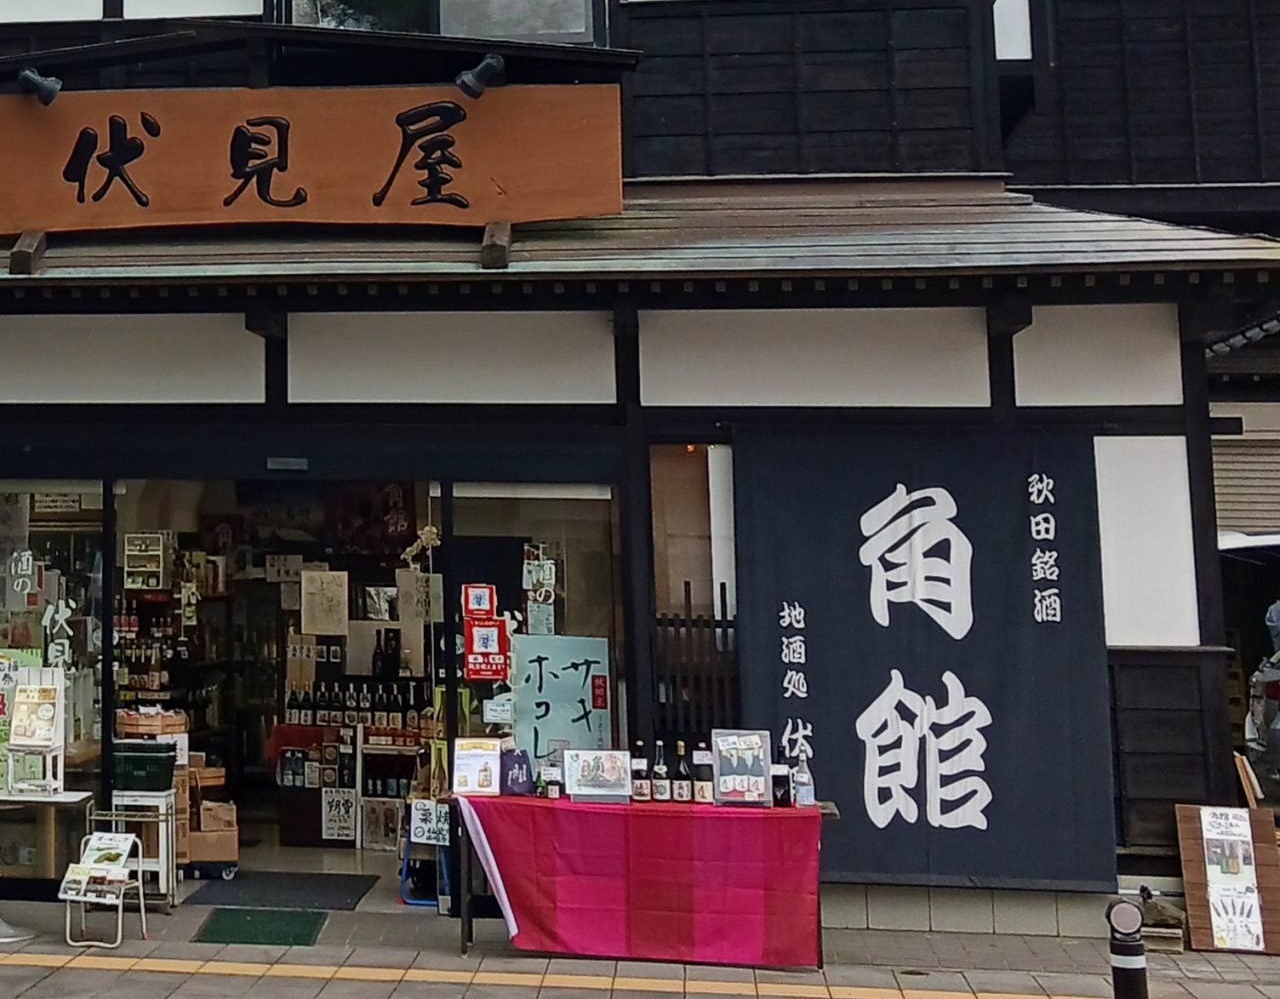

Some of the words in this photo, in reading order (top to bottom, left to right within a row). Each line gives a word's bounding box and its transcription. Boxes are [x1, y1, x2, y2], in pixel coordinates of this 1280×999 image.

[62, 100, 471, 209] 伏見屋
[1027, 473, 1062, 623] 秋田銘酒
[855, 483, 993, 831] 角館
